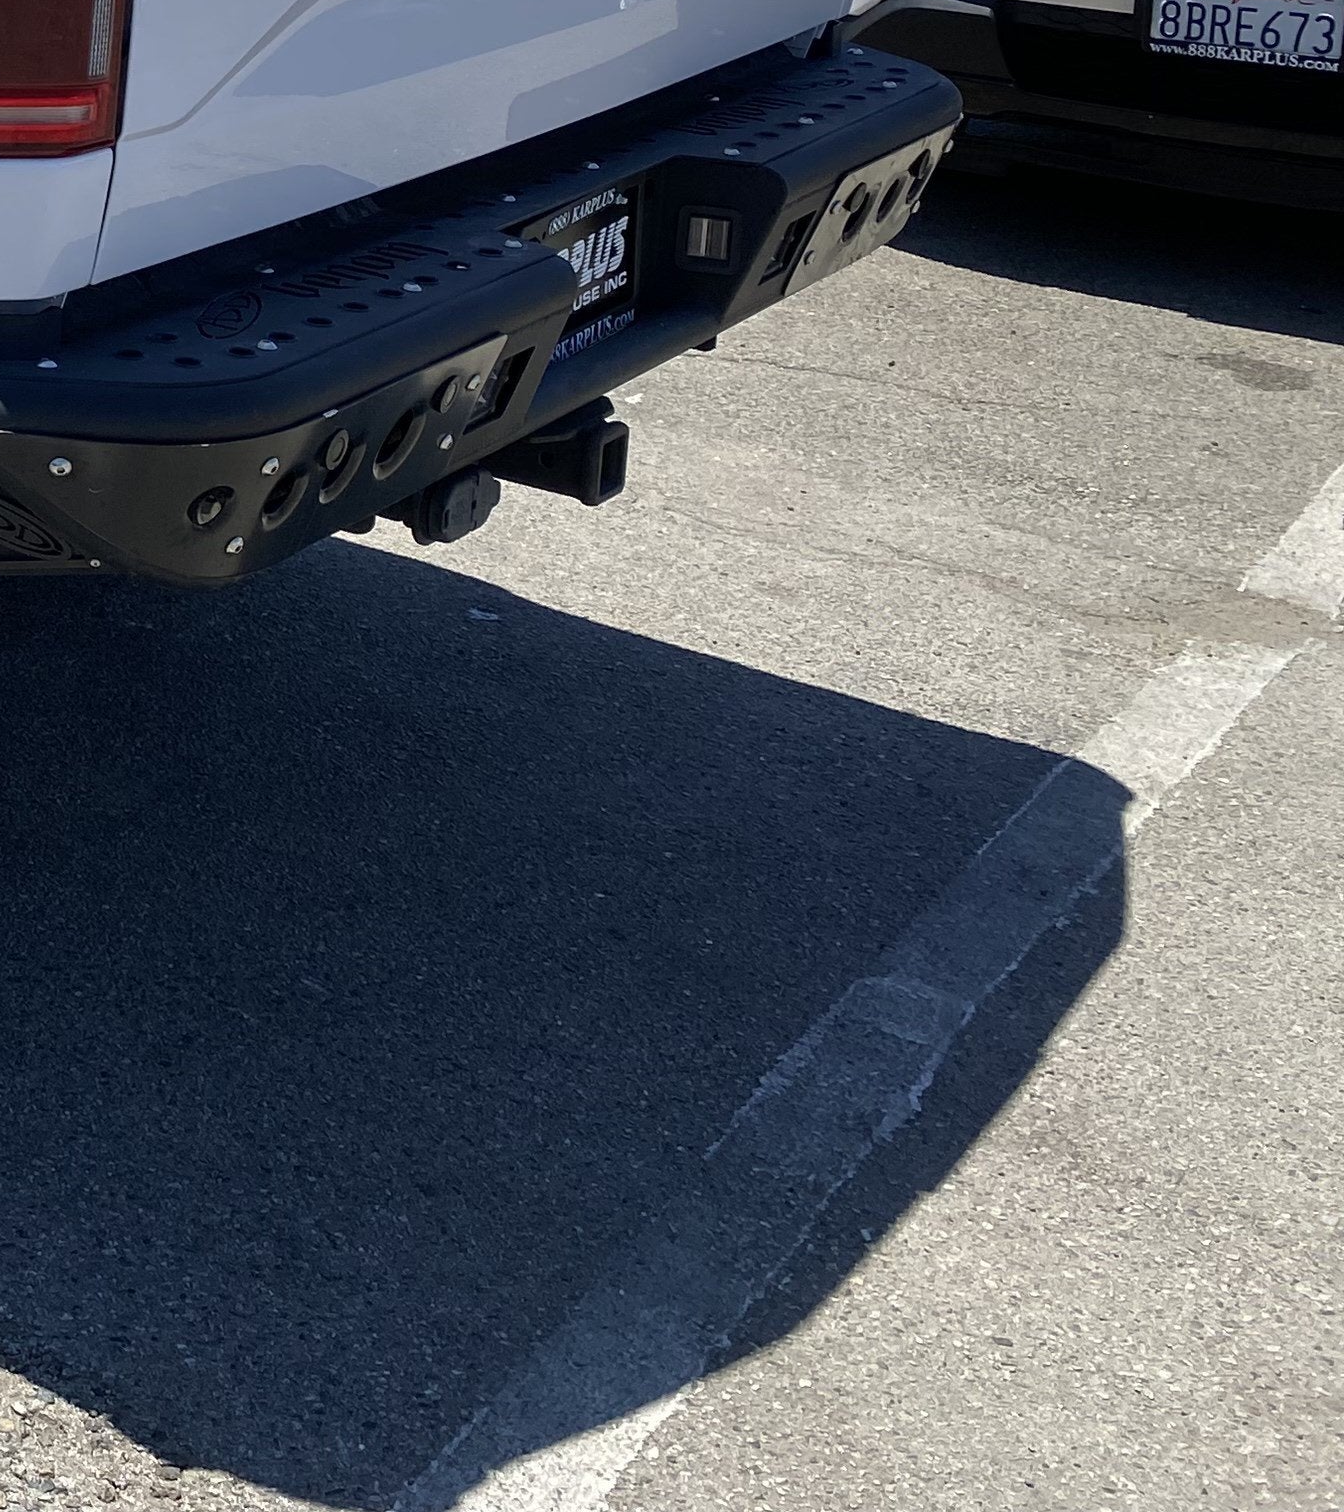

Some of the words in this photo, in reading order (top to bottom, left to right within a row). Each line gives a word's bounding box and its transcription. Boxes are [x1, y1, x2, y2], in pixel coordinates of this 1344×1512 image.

[1159, 0, 1336, 55] 8BRE673
[571, 188, 617, 224] KARPLUS
[604, 271, 628, 295] INC
